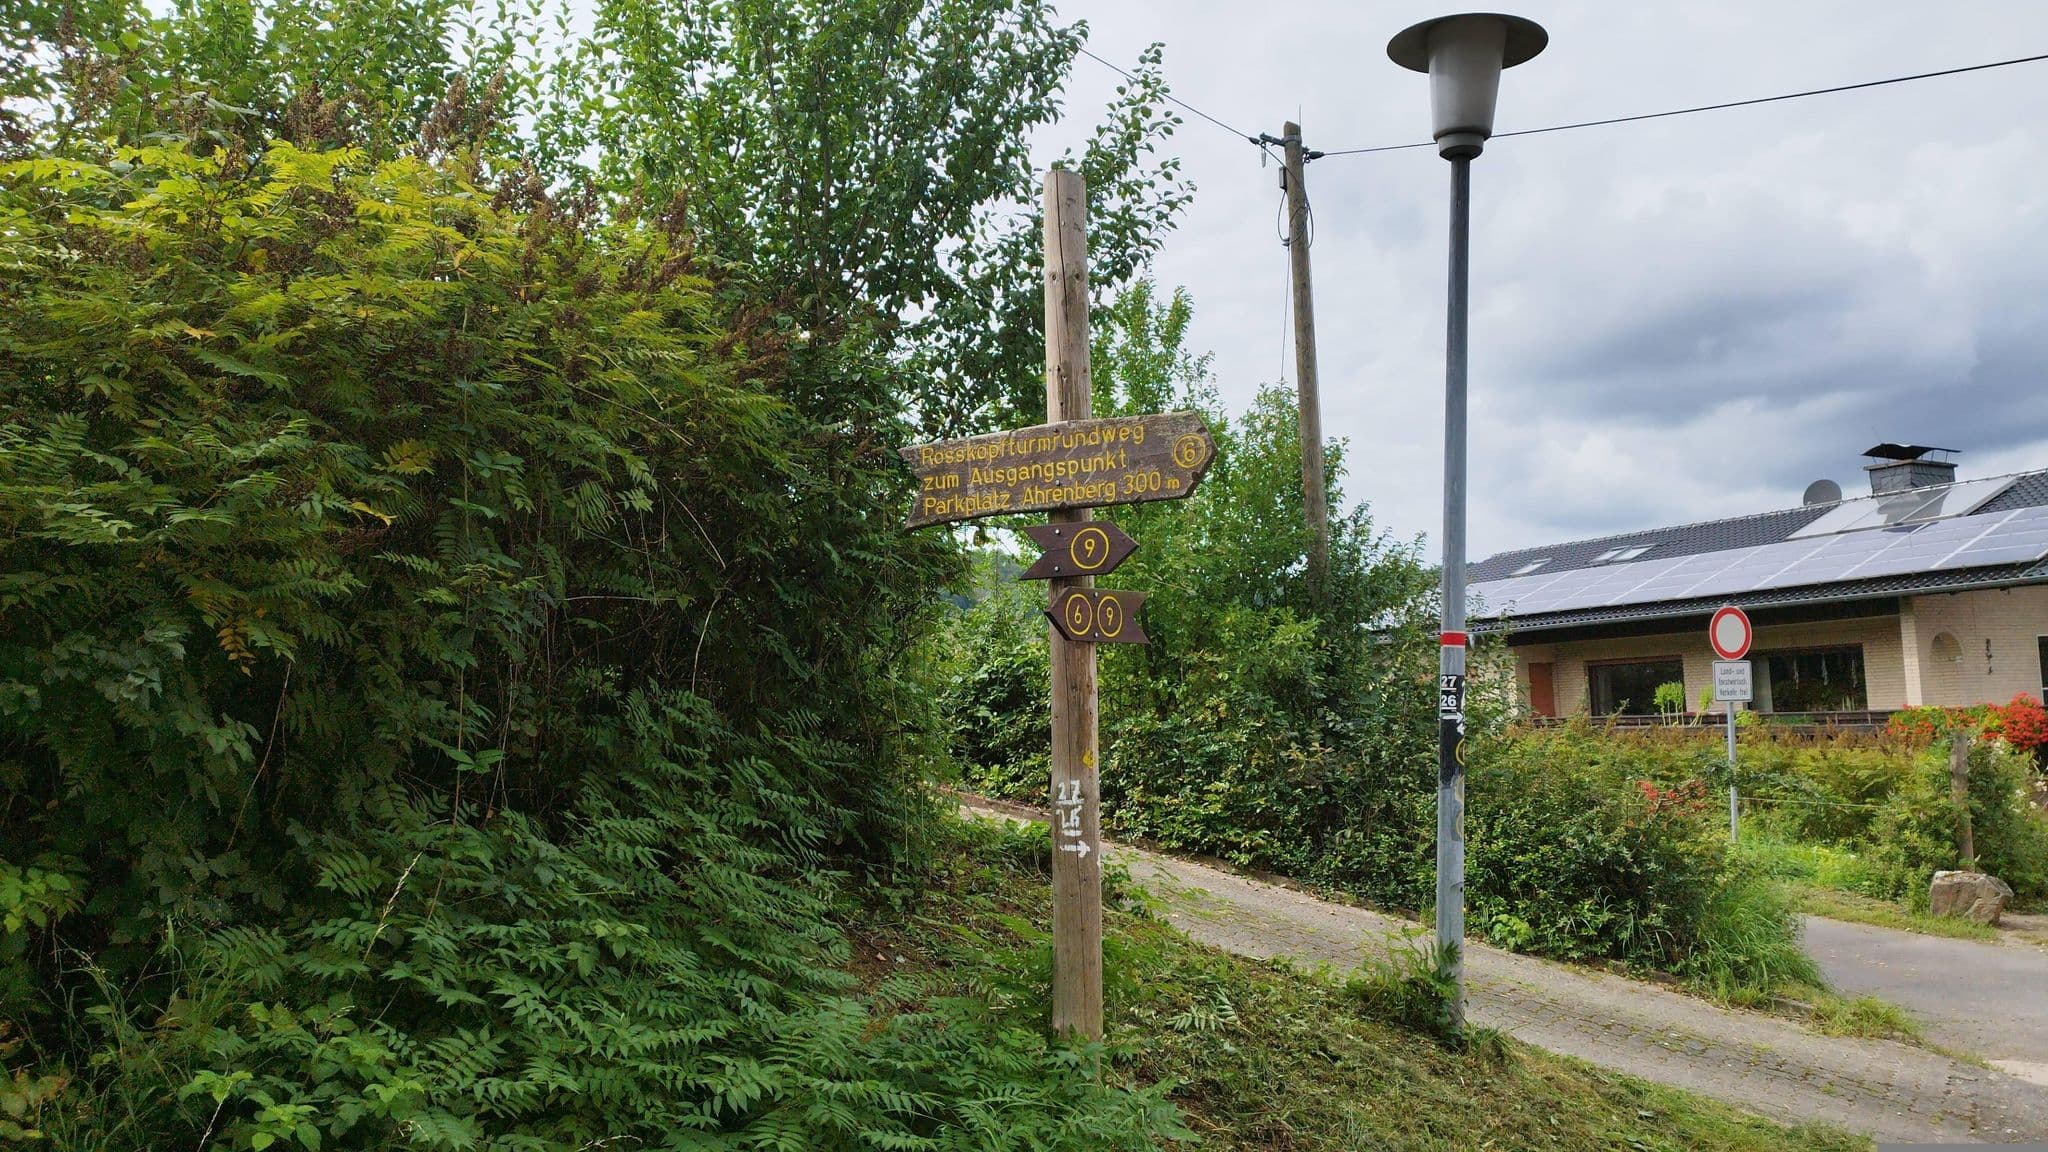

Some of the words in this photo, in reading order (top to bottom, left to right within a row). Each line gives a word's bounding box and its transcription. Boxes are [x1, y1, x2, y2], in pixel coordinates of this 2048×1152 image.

[921, 422, 1145, 465] Rosskopfturmrundweg
[1182, 441, 1196, 462] 6
[923, 473, 959, 492] zum
[970, 449, 1127, 488] Ausgangspunkt
[924, 492, 1011, 516] Parkplatz
[1023, 480, 1117, 506] Ahrenberg
[1122, 471, 1161, 494] 300
[1167, 478, 1181, 490] m
[1084, 538, 1095, 558] 9
[1074, 605, 1082, 624] 6
[1106, 607, 1114, 626] 9
[1441, 675, 1457, 688] 27
[1441, 695, 1457, 707] 26
